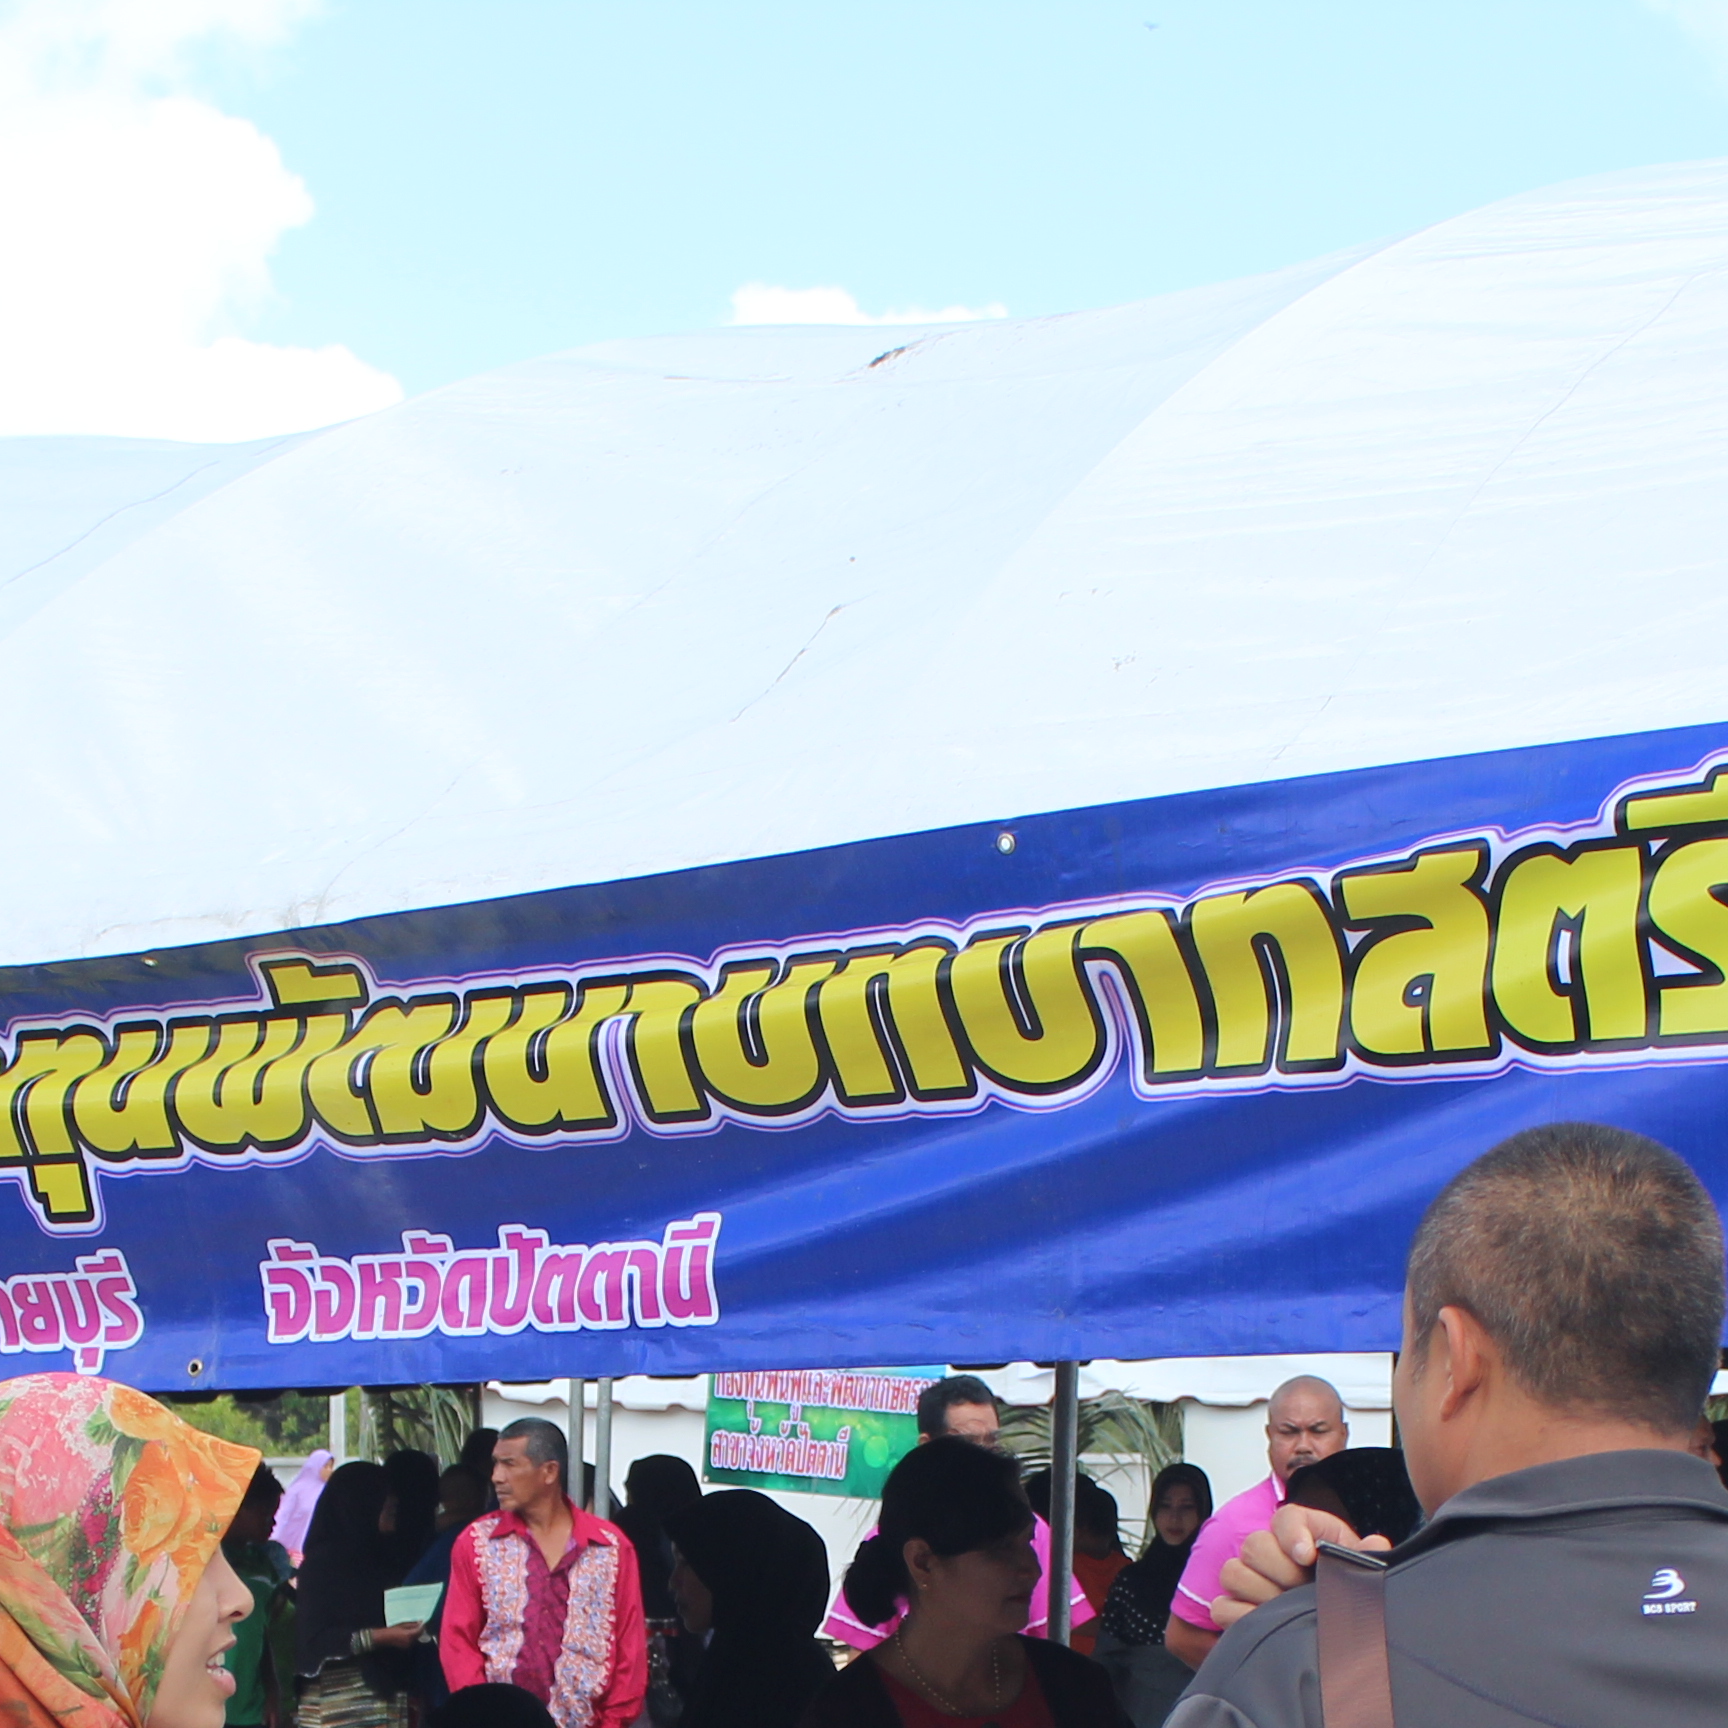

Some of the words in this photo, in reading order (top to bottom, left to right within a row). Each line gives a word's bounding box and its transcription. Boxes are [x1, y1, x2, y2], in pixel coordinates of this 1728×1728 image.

[261, 1212, 722, 1344] จังหวัดปัตตานี
[710, 1417, 852, 1478] สาขาจังหวัดปัตตานี
